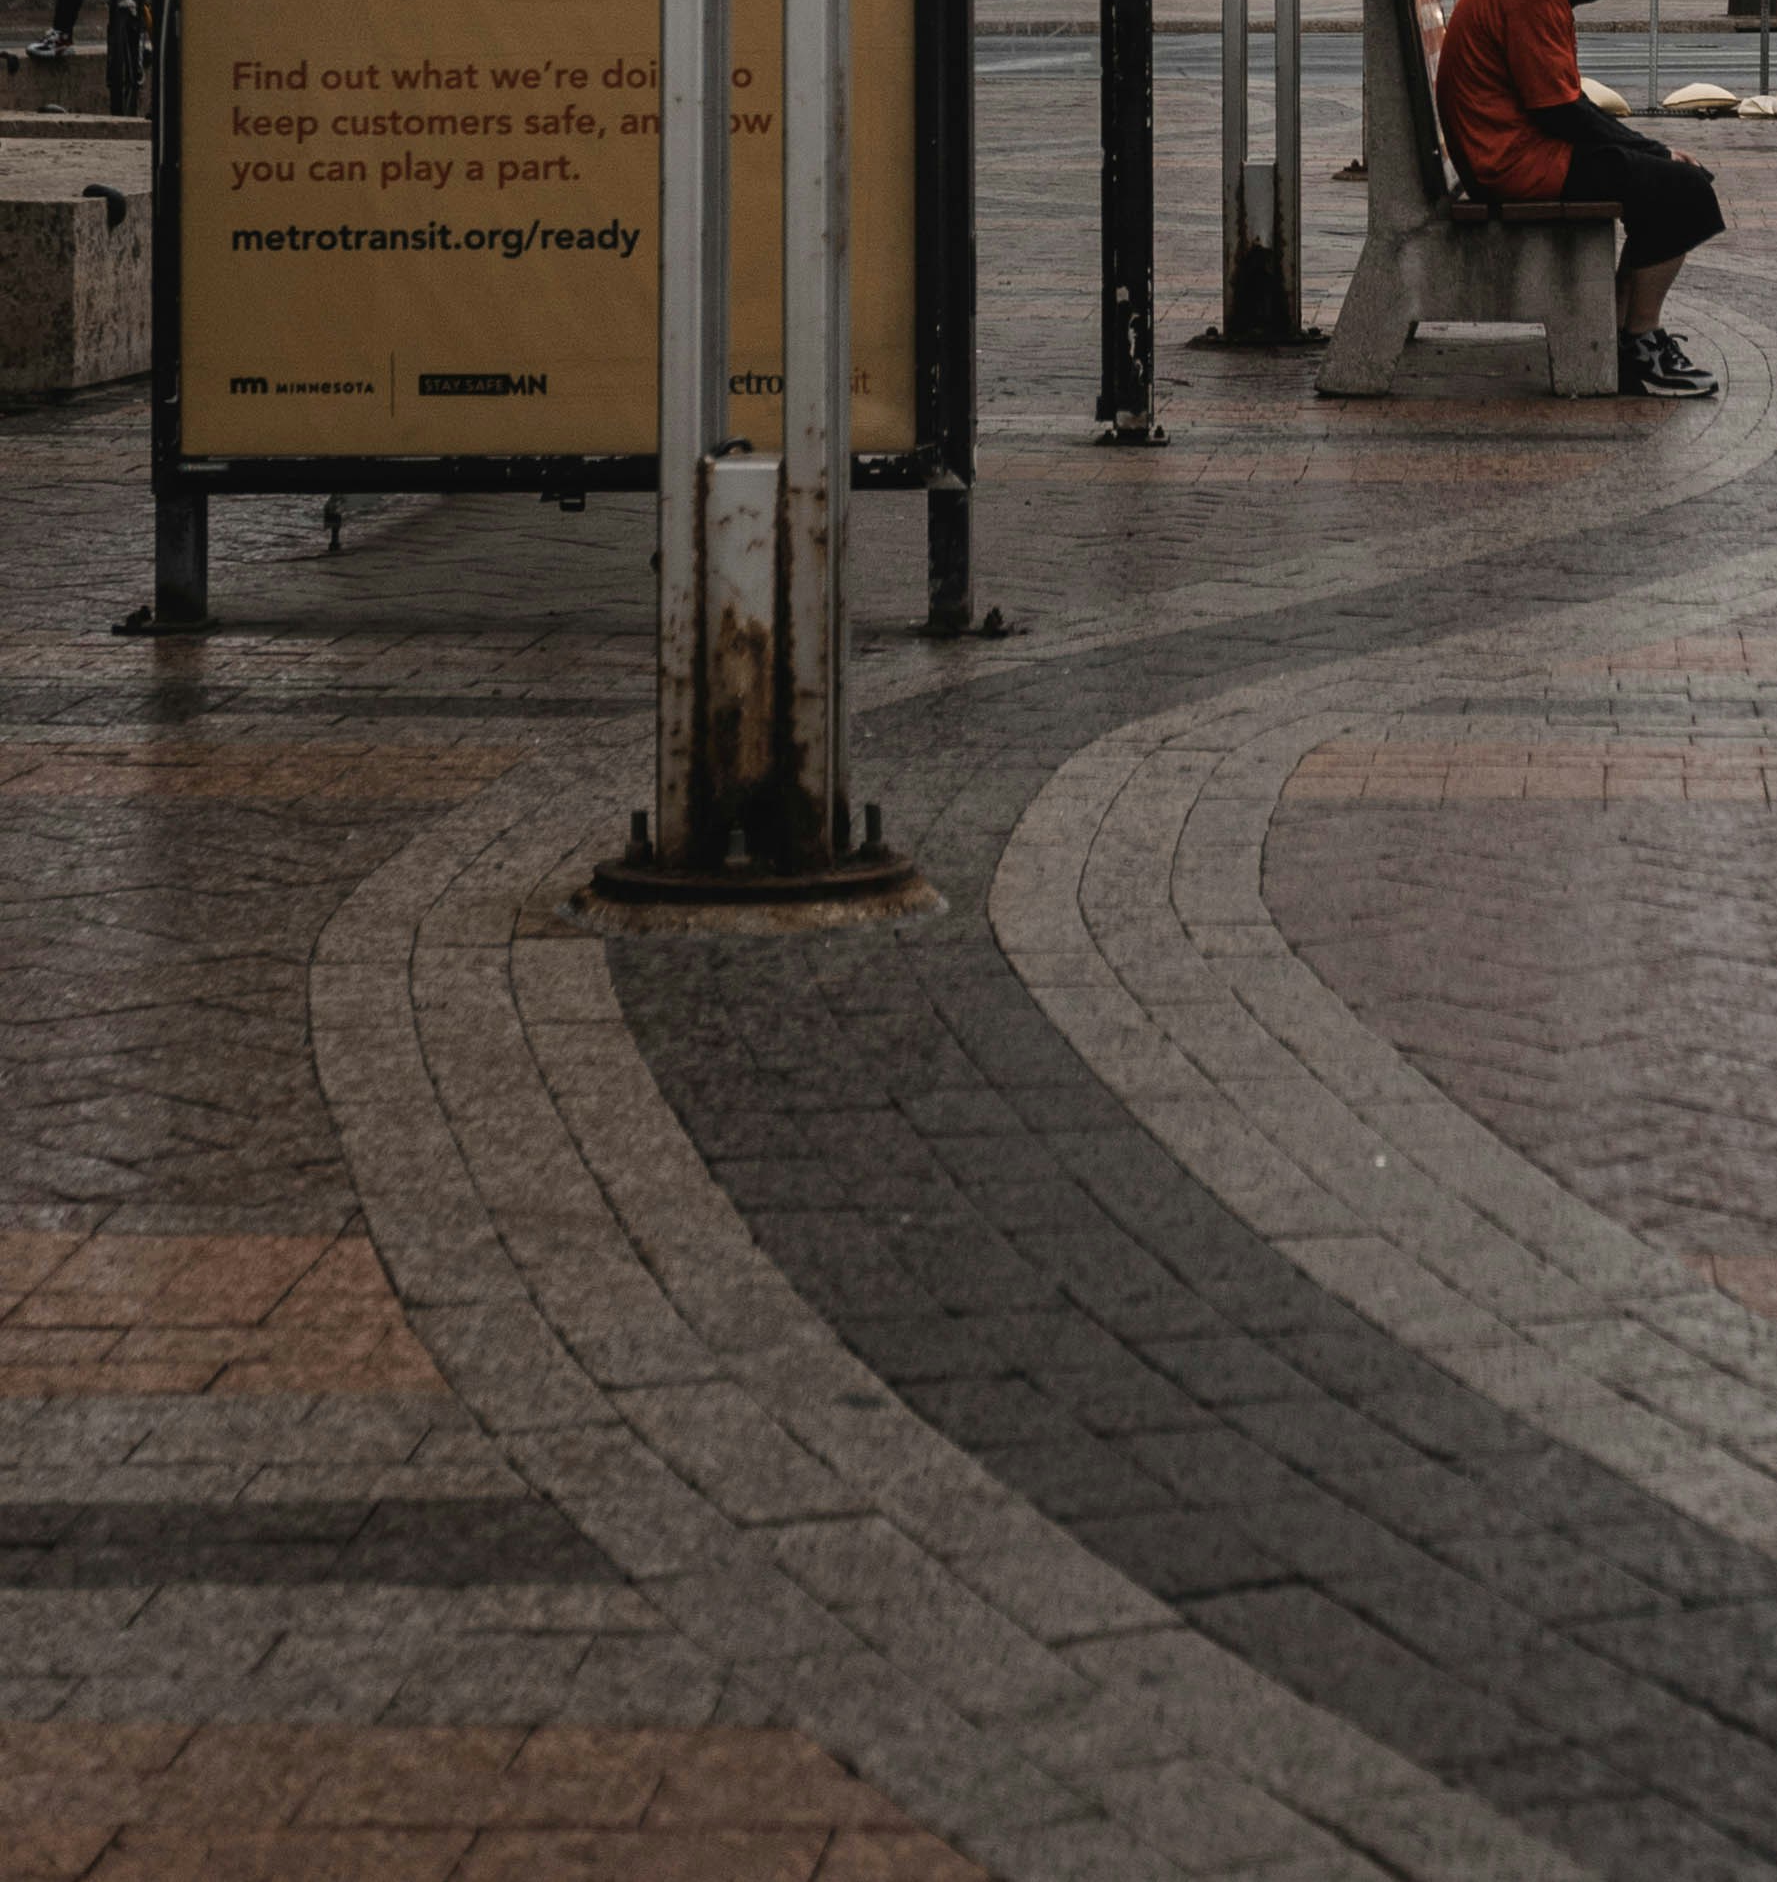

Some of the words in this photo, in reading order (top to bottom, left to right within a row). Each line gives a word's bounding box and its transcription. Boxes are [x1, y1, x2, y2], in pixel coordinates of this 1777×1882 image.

[233, 62, 309, 91] Find
[322, 66, 381, 91] out
[393, 61, 479, 90] what
[233, 107, 320, 145] keep
[332, 112, 513, 136] customers
[526, 105, 606, 140] safe,
[621, 115, 661, 136] an
[232, 162, 296, 192] you
[309, 162, 368, 182] can
[382, 152, 455, 191] play
[467, 161, 485, 182] a
[499, 157, 581, 191] part.
[232, 220, 641, 261] metrotransit.org/ready
[423, 378, 462, 392] STAY
[465, 378, 505, 392] SAFE
[508, 375, 548, 396] MN
[728, 372, 783, 396] etro
